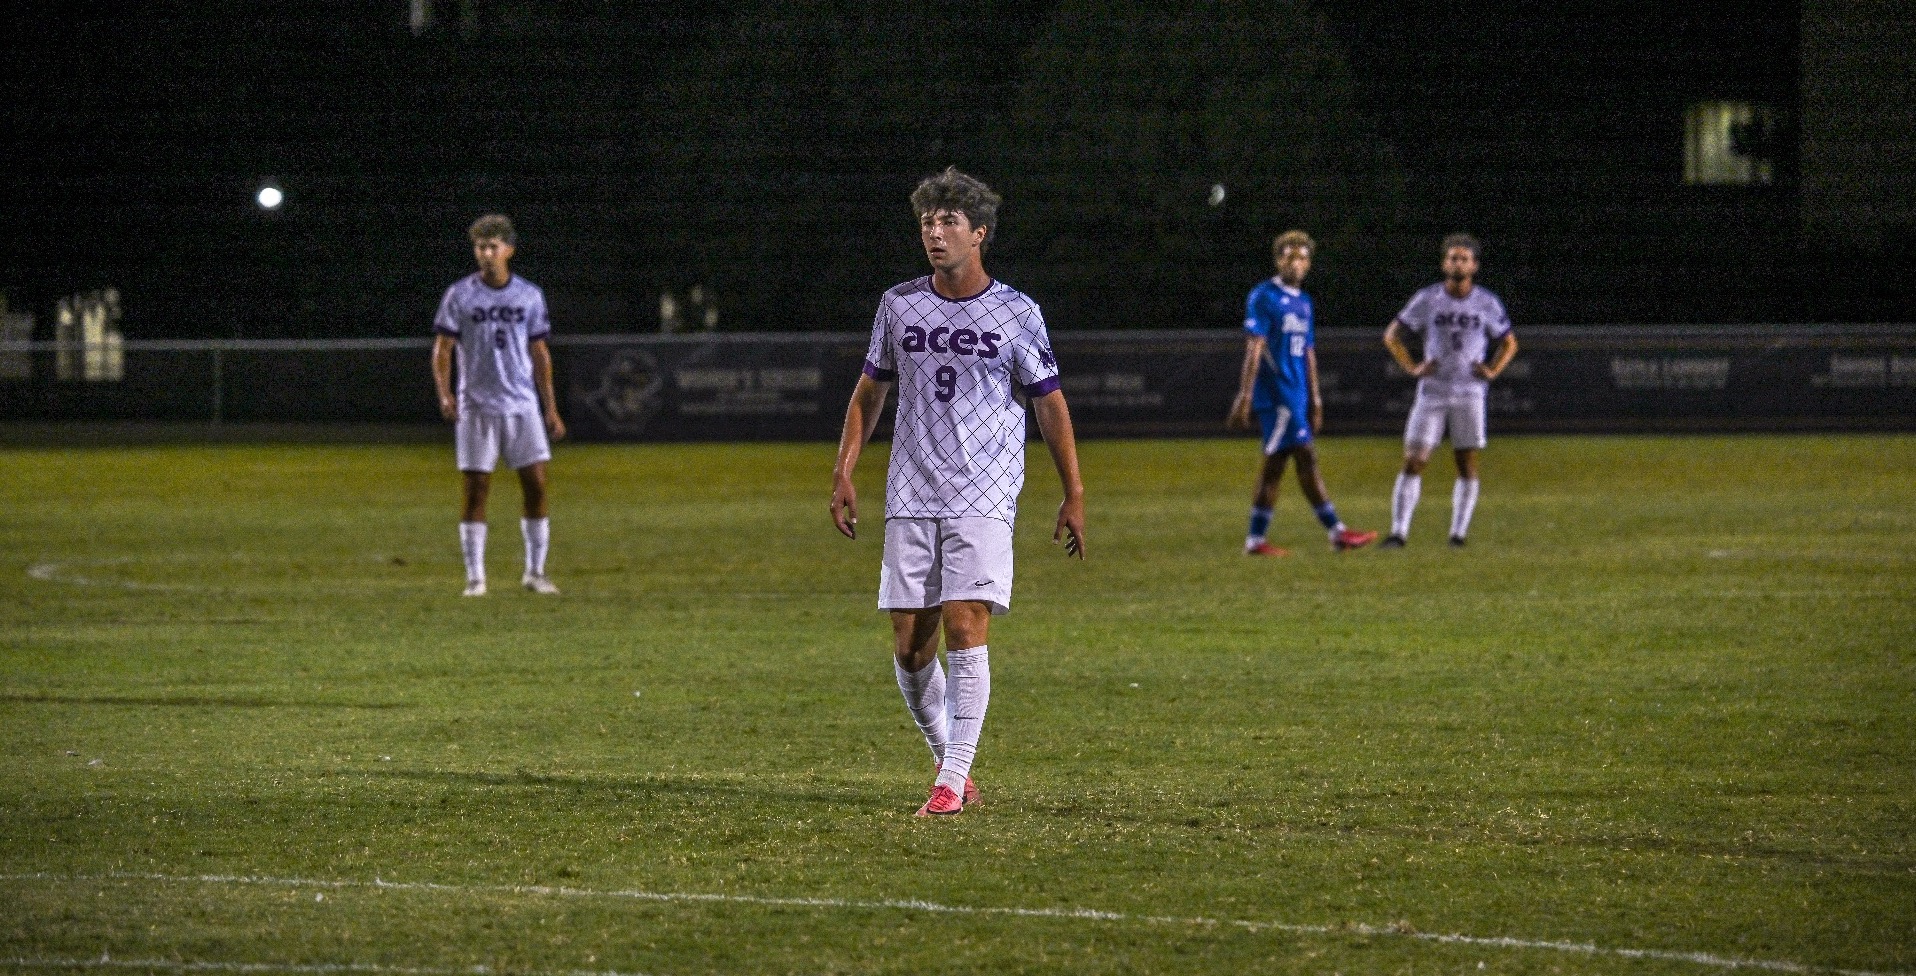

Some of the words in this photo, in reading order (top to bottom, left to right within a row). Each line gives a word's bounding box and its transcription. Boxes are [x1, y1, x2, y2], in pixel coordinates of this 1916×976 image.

[472, 305, 525, 324] aces
[902, 325, 1002, 359] aces
[934, 365, 958, 402] 9
